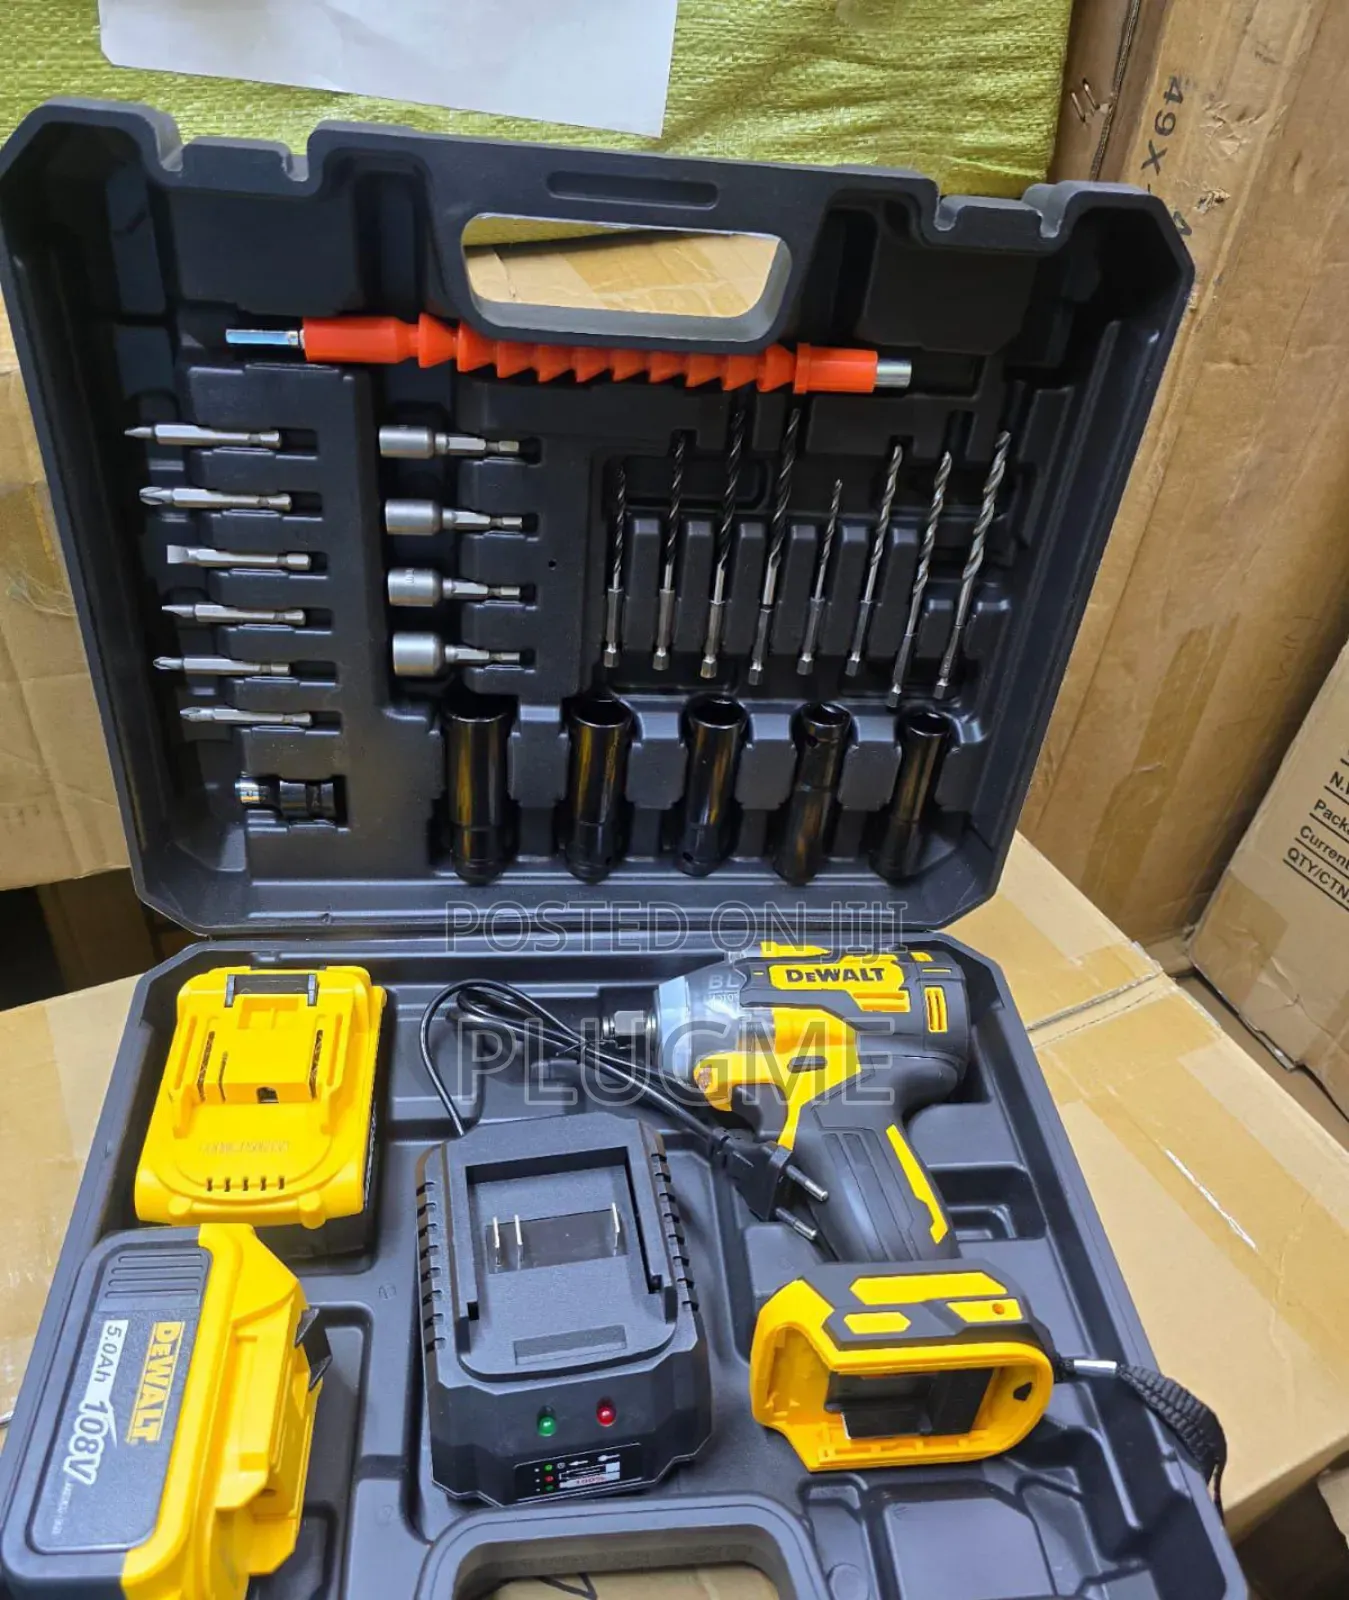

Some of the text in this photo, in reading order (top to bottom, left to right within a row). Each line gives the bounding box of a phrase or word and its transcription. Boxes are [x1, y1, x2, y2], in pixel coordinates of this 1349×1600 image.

[786, 968, 885, 983] DEWALT
[93, 1324, 123, 1382] 5.0Ah
[132, 1321, 183, 1443] DEWALT
[67, 1399, 110, 1482] 108V
